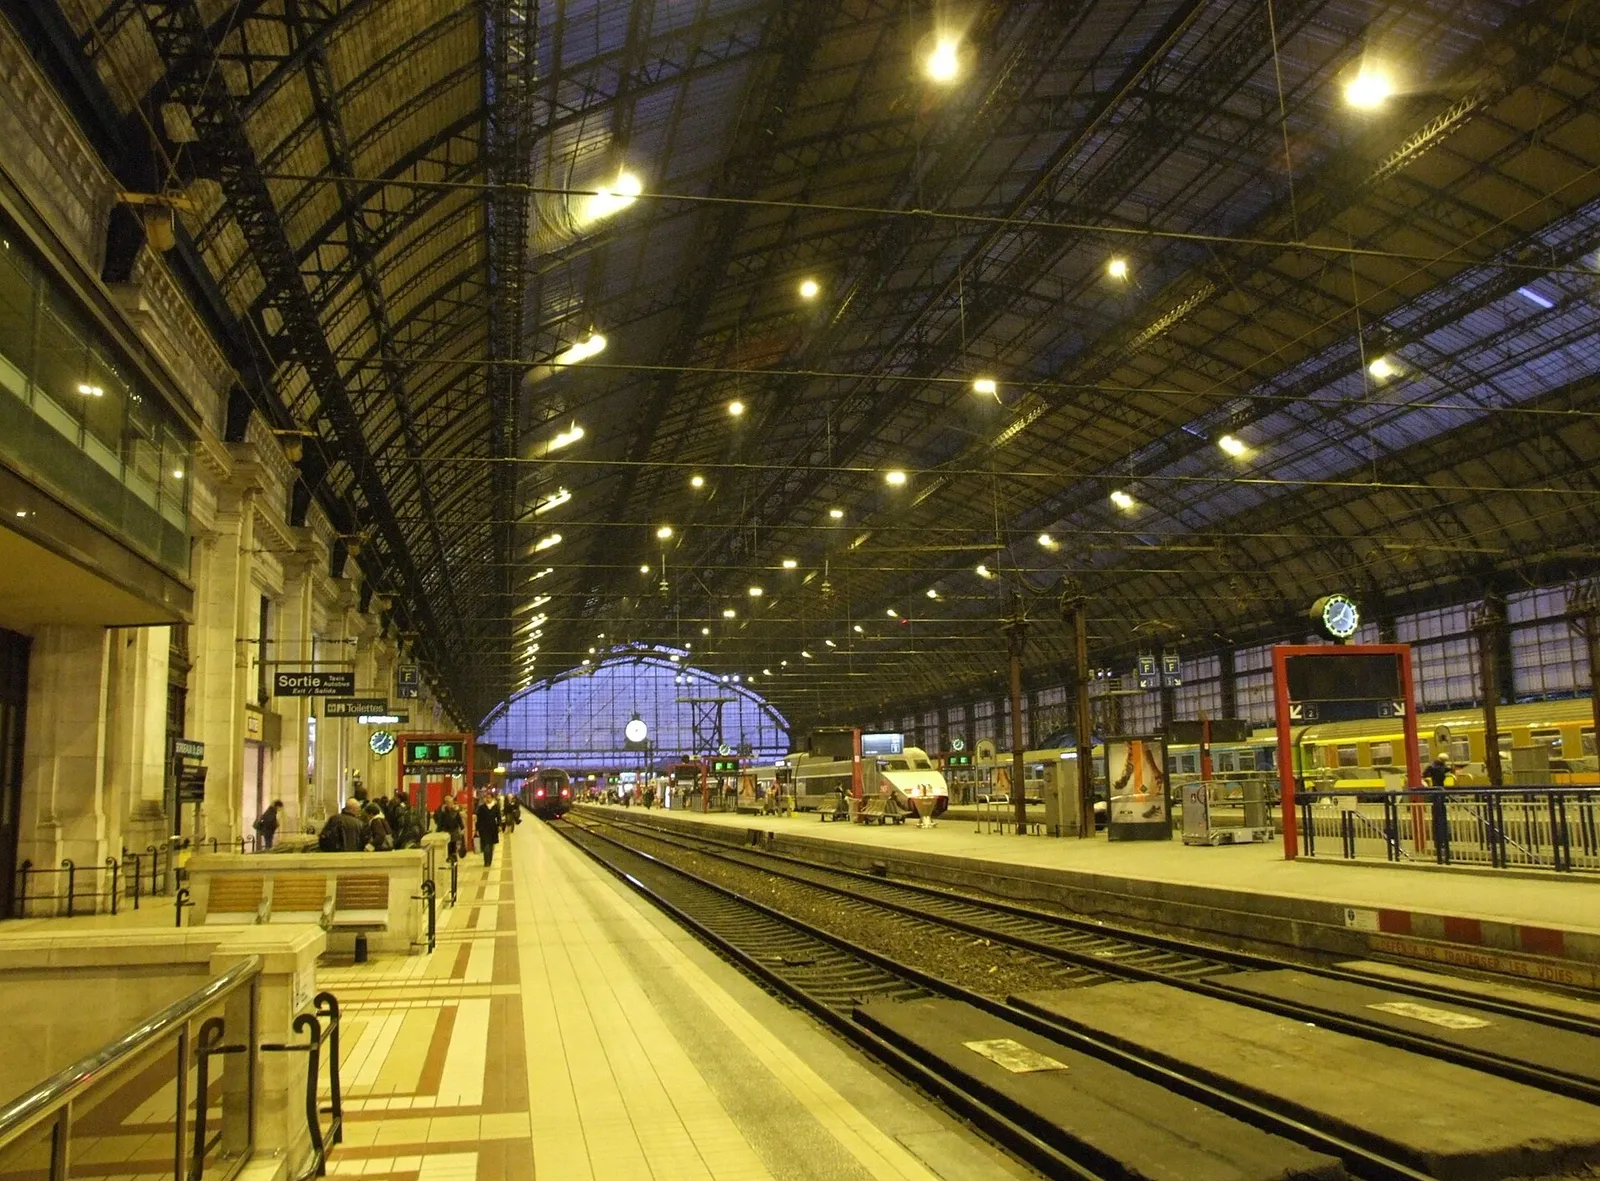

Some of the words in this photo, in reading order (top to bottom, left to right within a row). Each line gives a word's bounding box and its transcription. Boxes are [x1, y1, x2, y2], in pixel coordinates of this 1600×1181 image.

[278, 675, 321, 687] Sortie
[346, 703, 384, 712] Toilettes
[1308, 710, 1314, 718] 2
[1510, 961, 1528, 972] LES
[1536, 965, 1574, 982] VOIES
